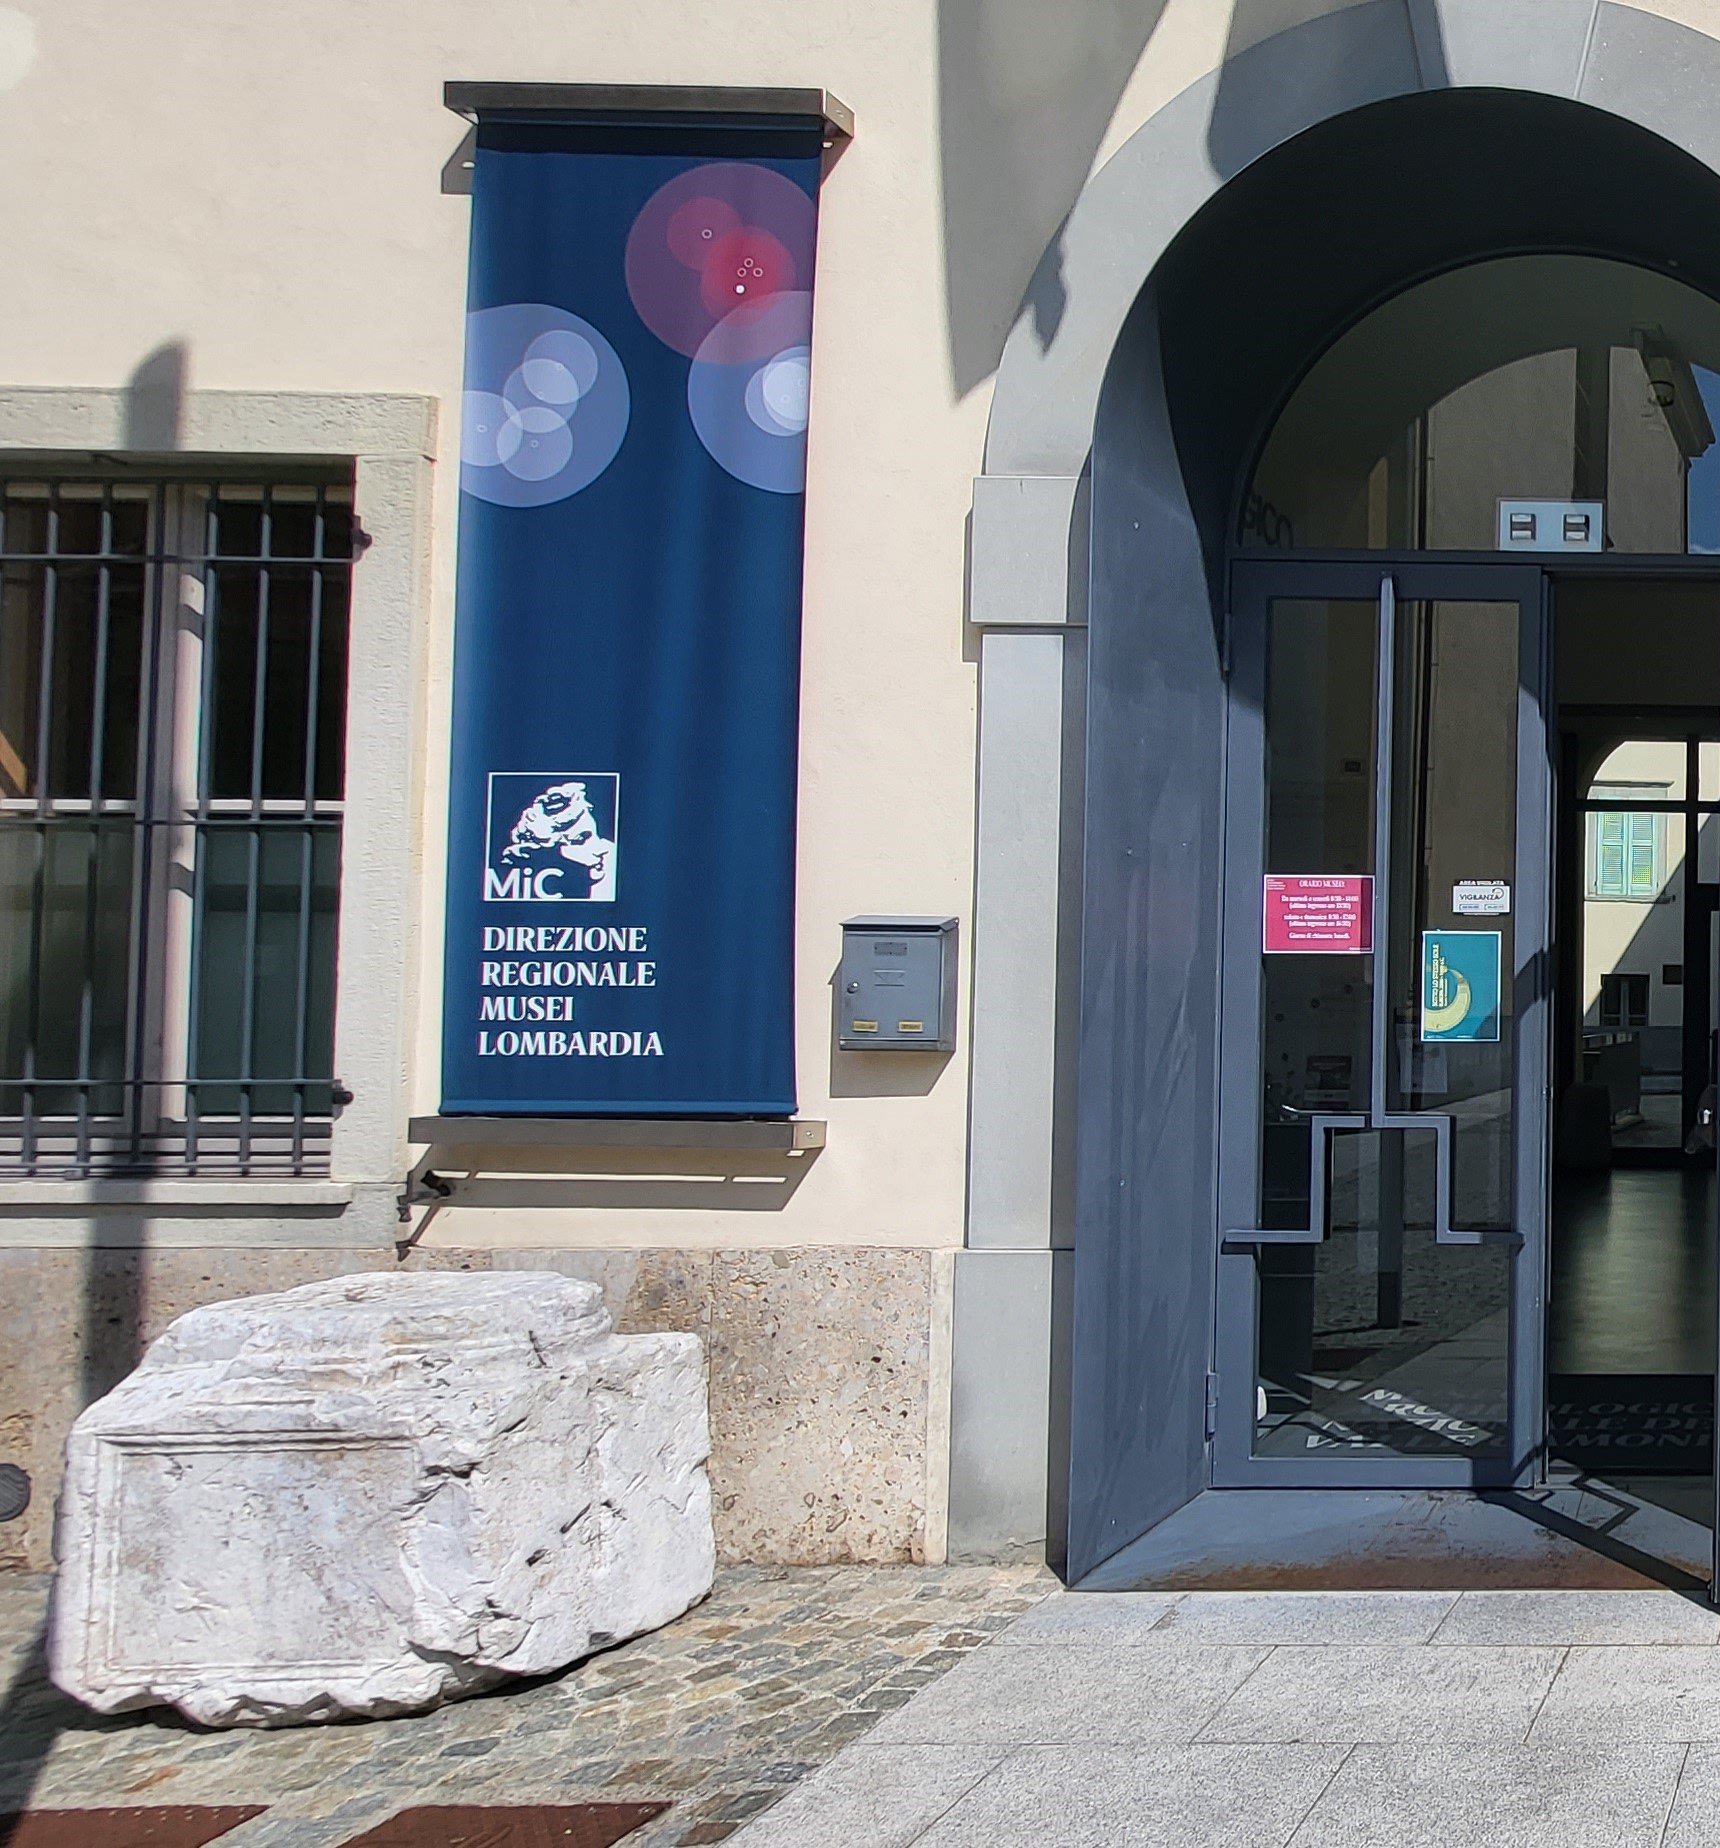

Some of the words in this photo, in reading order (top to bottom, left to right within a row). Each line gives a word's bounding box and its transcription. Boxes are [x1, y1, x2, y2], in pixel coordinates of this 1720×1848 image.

[487, 867, 565, 900] MiC
[1459, 893, 1499, 901] VIGILANZA
[482, 926, 648, 953] DIREZIONE
[480, 961, 657, 987] REGIONALE
[478, 996, 574, 1021] MUSEI
[477, 1030, 665, 1057] LOMBARDIA
